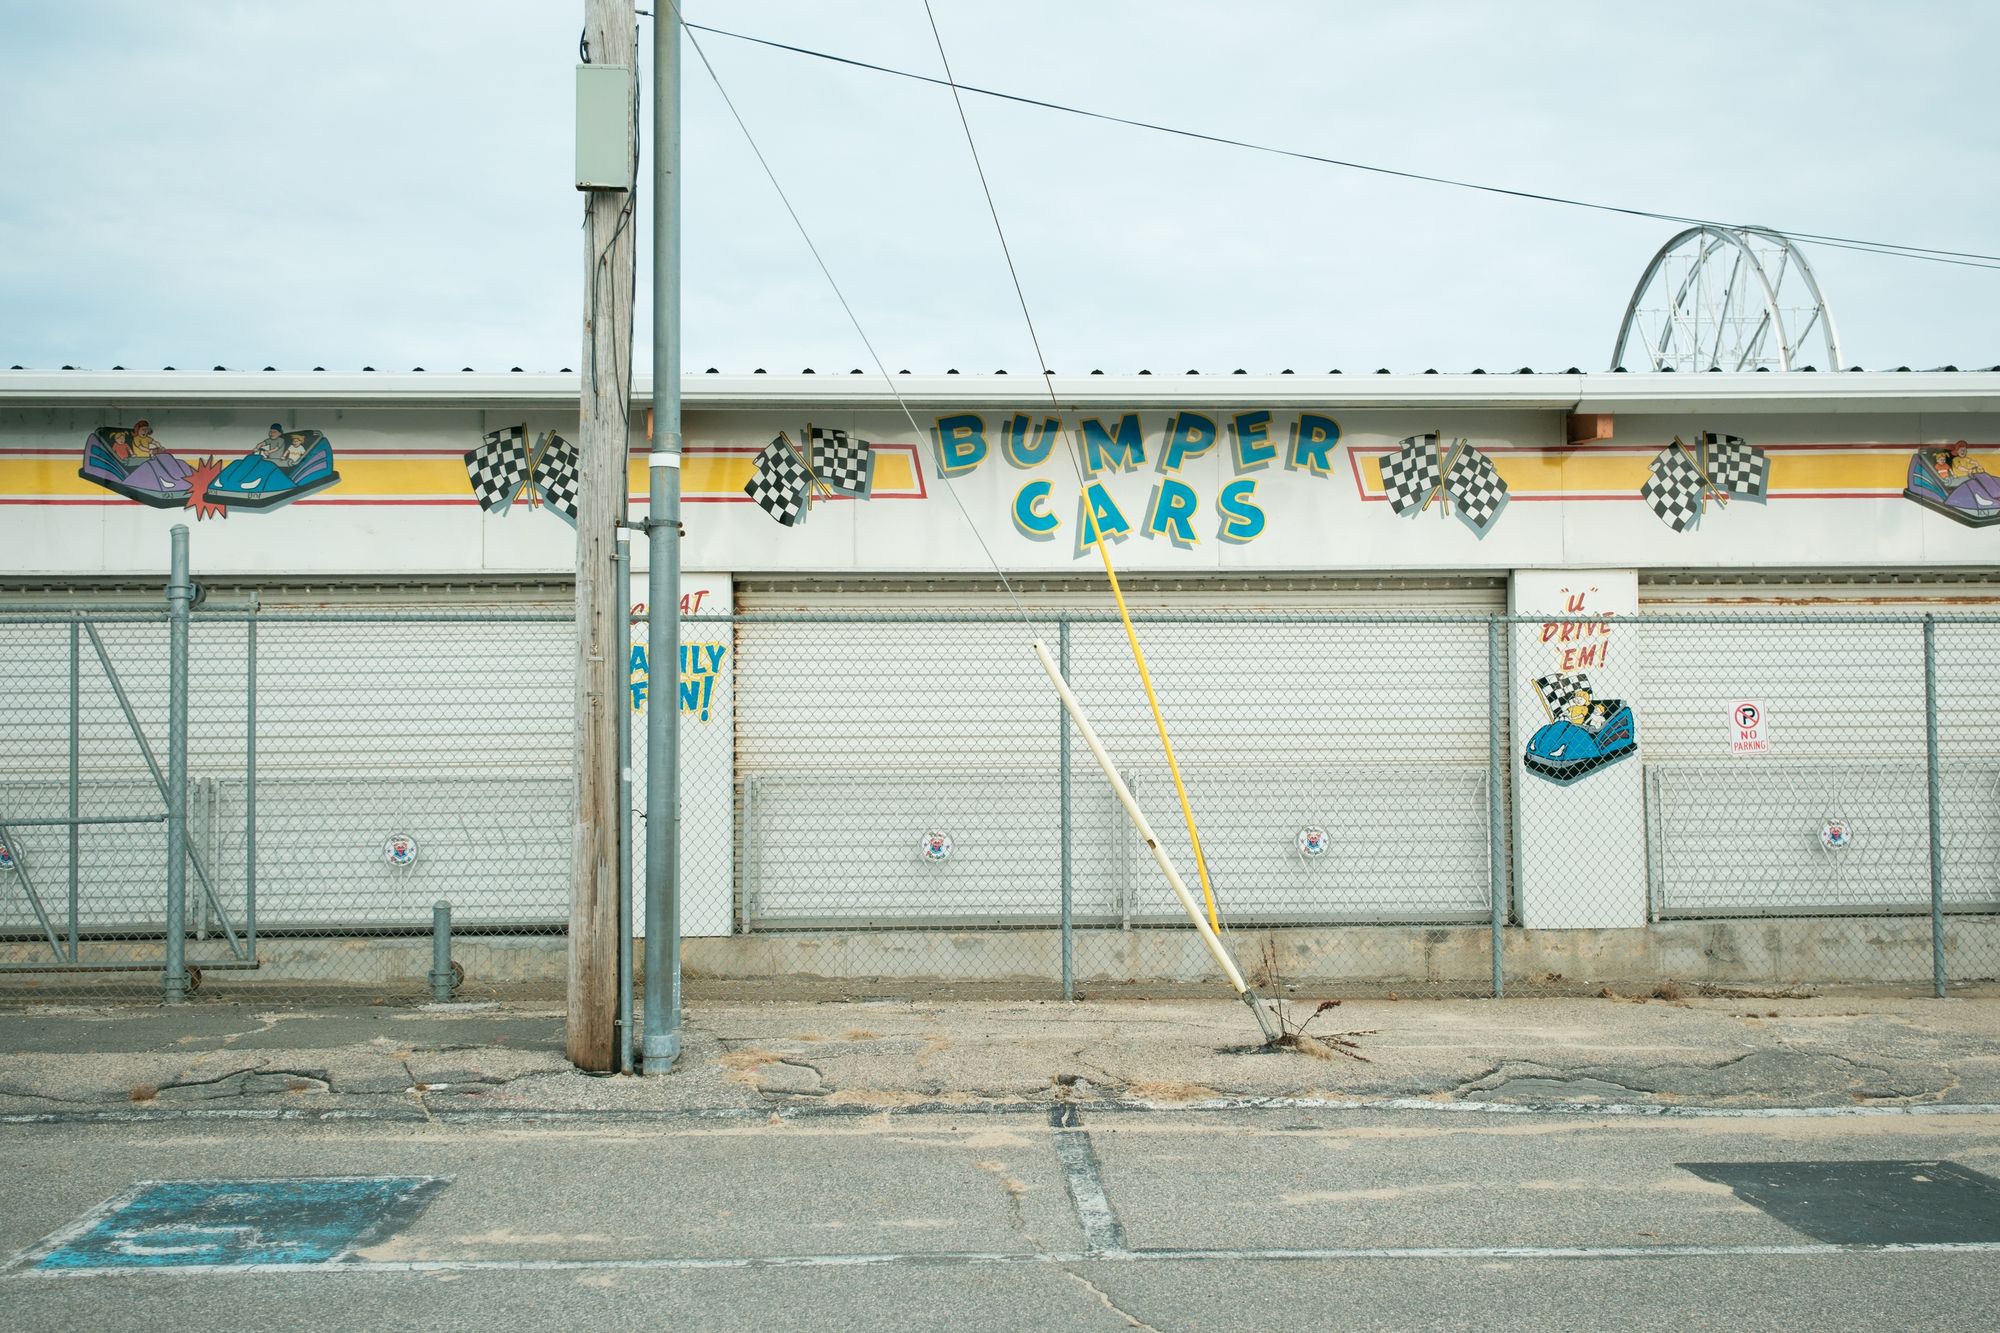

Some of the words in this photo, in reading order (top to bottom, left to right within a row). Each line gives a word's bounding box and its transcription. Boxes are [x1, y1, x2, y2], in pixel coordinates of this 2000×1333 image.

[930, 410, 1342, 479] BUMPER
[1011, 477, 1267, 559] CARS
[1539, 611, 1614, 643] DRIVE
[630, 643, 728, 674] AILY
[630, 675, 715, 723] FN!
[1733, 740, 1766, 752] PARKING
[1740, 730, 1757, 740] NO
